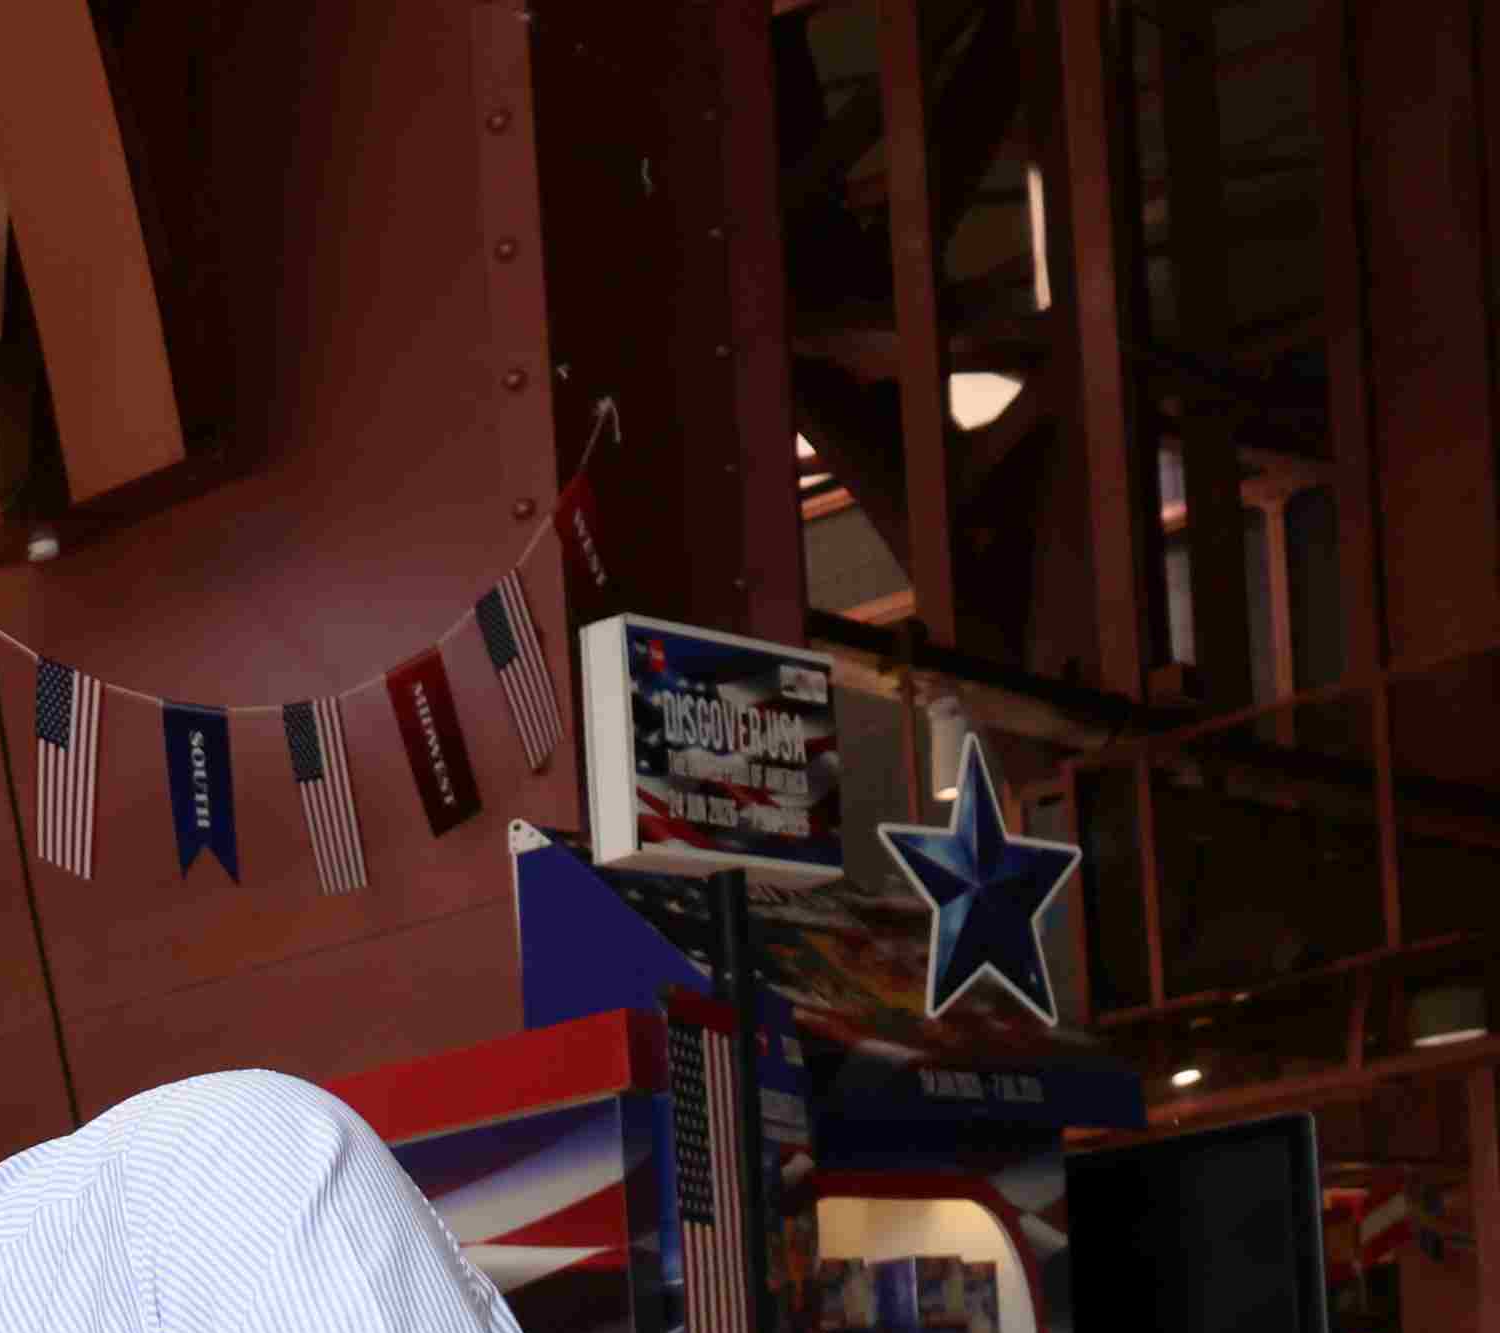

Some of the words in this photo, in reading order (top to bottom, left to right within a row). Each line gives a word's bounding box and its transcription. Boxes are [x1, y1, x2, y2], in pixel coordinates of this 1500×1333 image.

[411, 680, 456, 806] MIDWEST
[663, 690, 763, 759] DISCOVER
[188, 731, 211, 829] SOUTH
